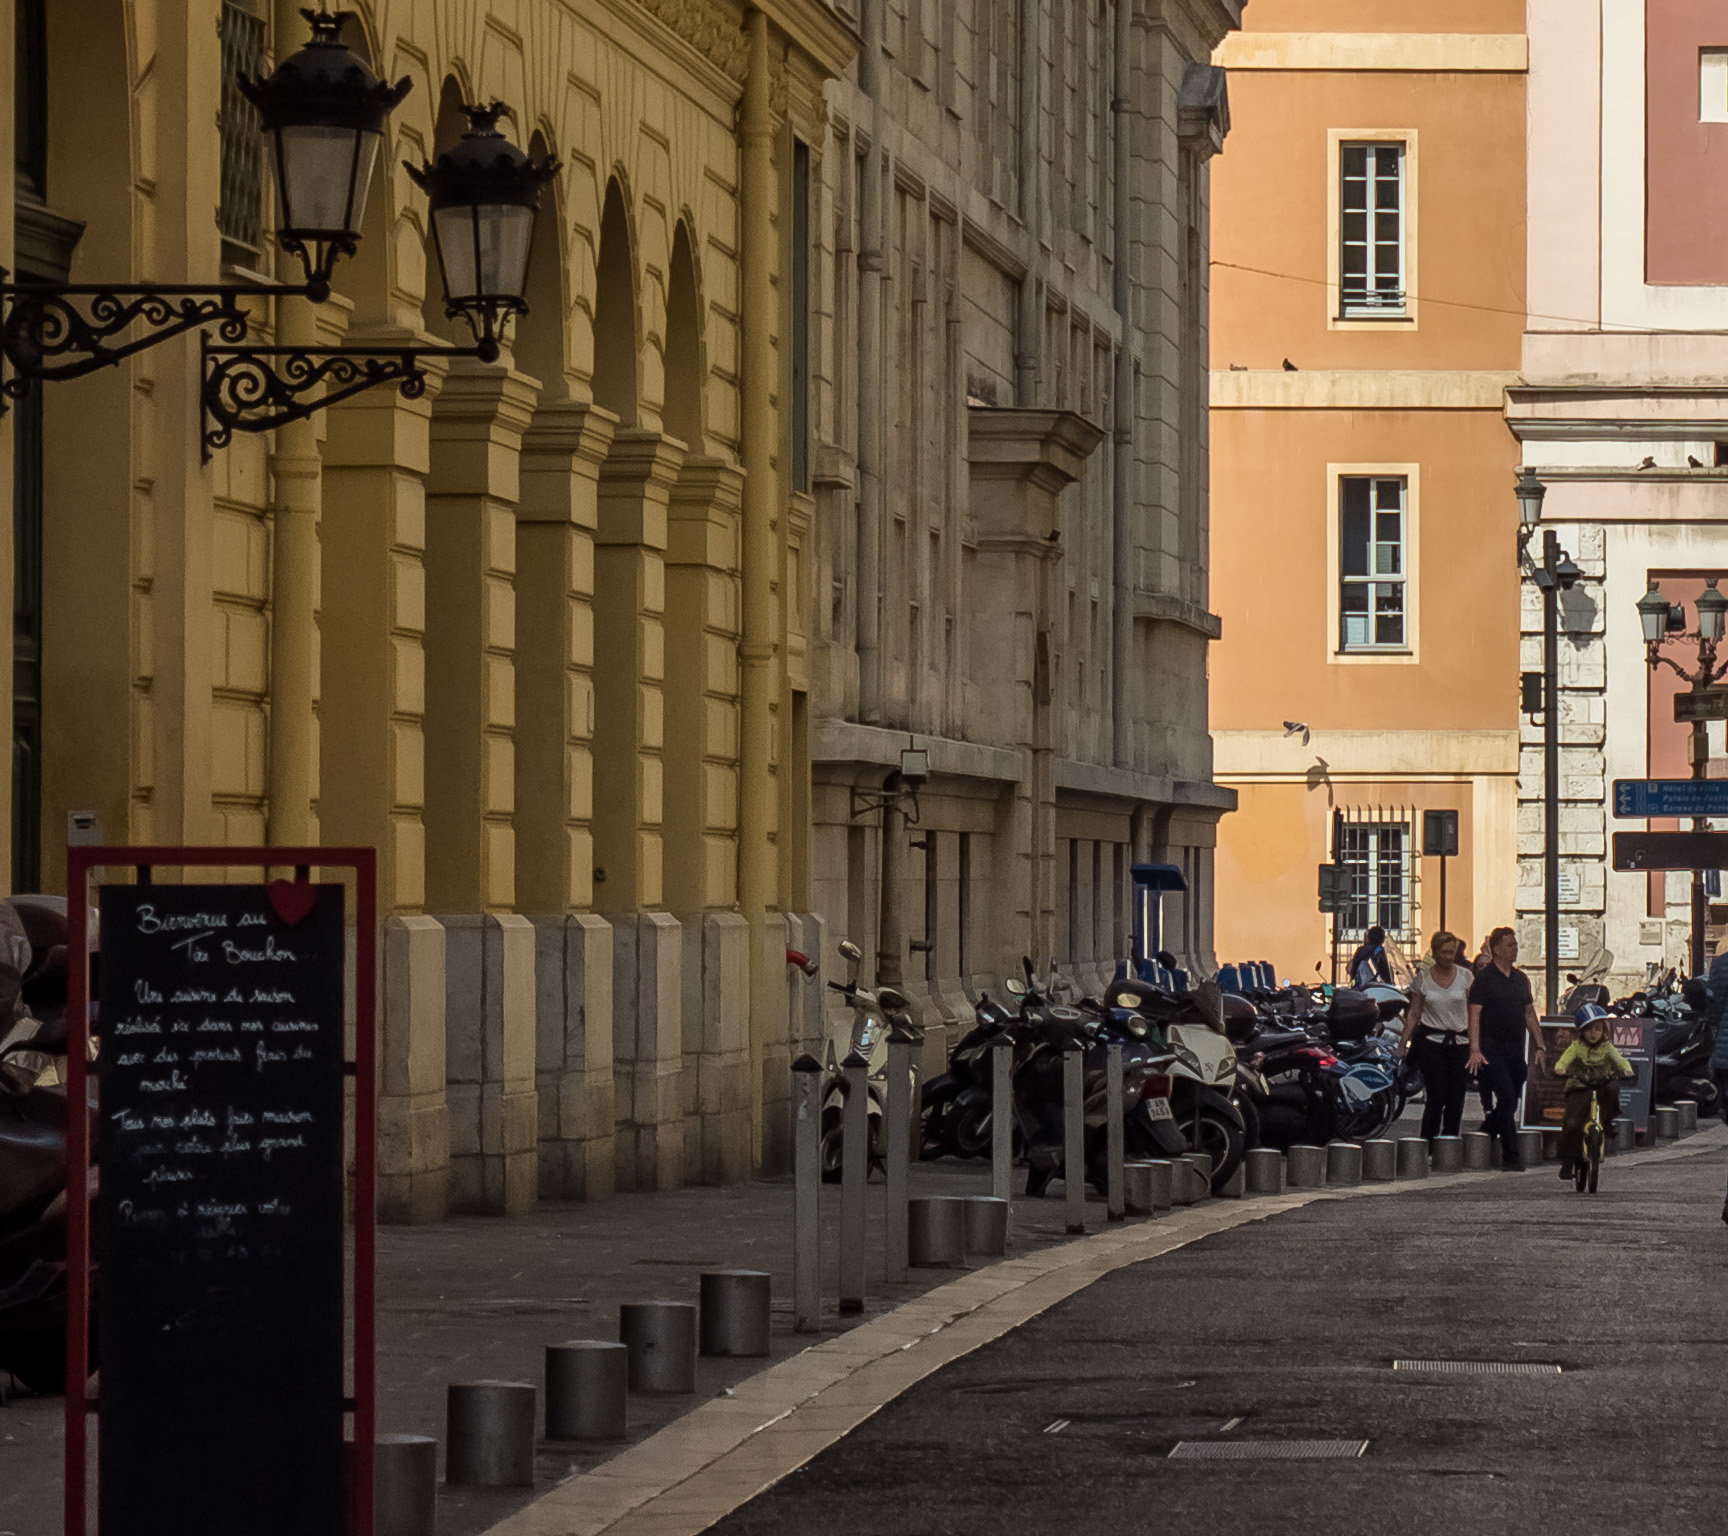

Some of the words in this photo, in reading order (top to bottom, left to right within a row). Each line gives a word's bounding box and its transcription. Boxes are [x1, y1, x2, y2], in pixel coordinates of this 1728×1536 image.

[1663, 784, 1685, 792] Hôtel
[1663, 794, 1689, 802] Palais
[136, 904, 228, 934] Bienvenue
[237, 913, 267, 927] au
[221, 935, 296, 964] Bouchon
[134, 978, 163, 1004] Une
[224, 987, 243, 1003] de
[197, 1017, 232, 1032] dans
[240, 1020, 264, 1032] nos
[111, 1108, 144, 1130] Tous
[151, 1116, 174, 1128] nos
[258, 1134, 306, 1162] grand
